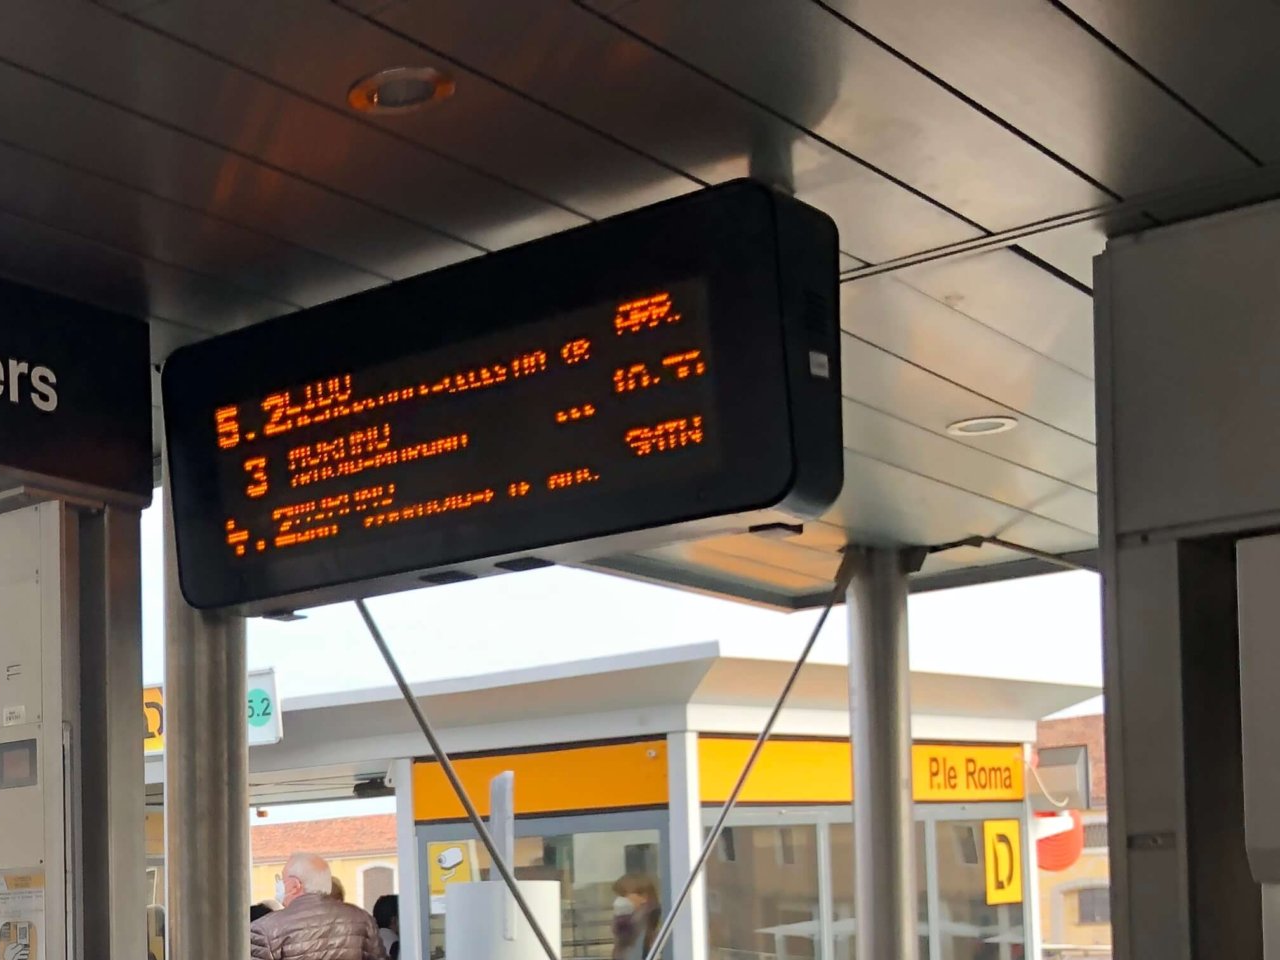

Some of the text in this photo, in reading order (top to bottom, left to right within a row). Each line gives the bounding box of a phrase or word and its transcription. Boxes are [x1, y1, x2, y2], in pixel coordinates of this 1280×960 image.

[929, 757, 1013, 791] P.le Roma
[992, 833, 1014, 891] D
